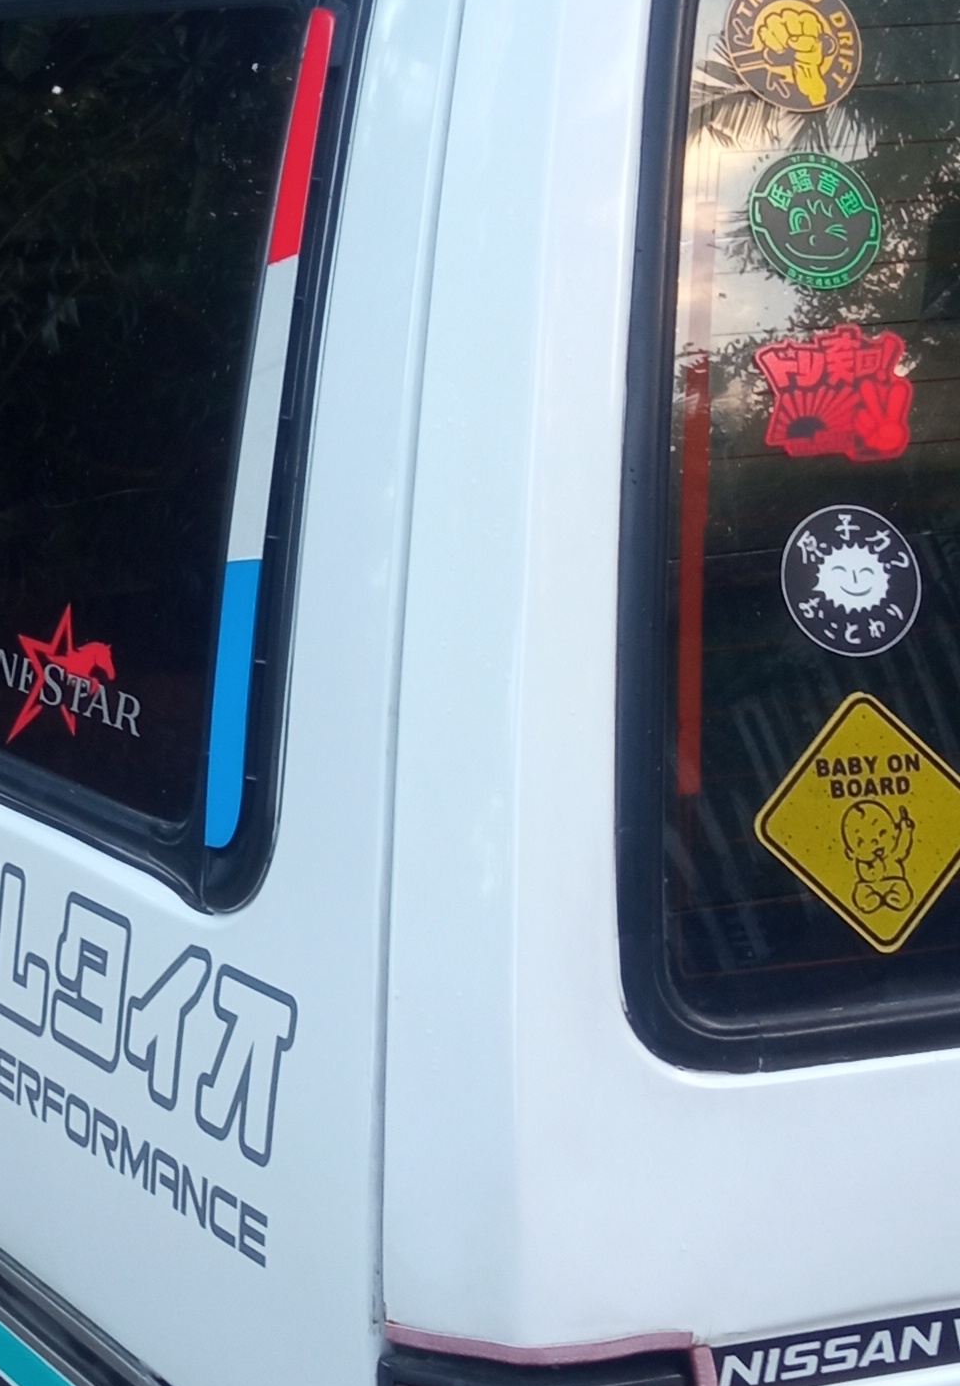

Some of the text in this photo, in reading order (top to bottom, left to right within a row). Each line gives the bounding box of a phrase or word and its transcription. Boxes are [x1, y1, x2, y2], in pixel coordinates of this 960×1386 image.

[828, 10, 855, 89] DRIFT
[798, 595, 904, 645] おことわり
[815, 753, 921, 778] BABY ON
[830, 776, 911, 799] BOARD
